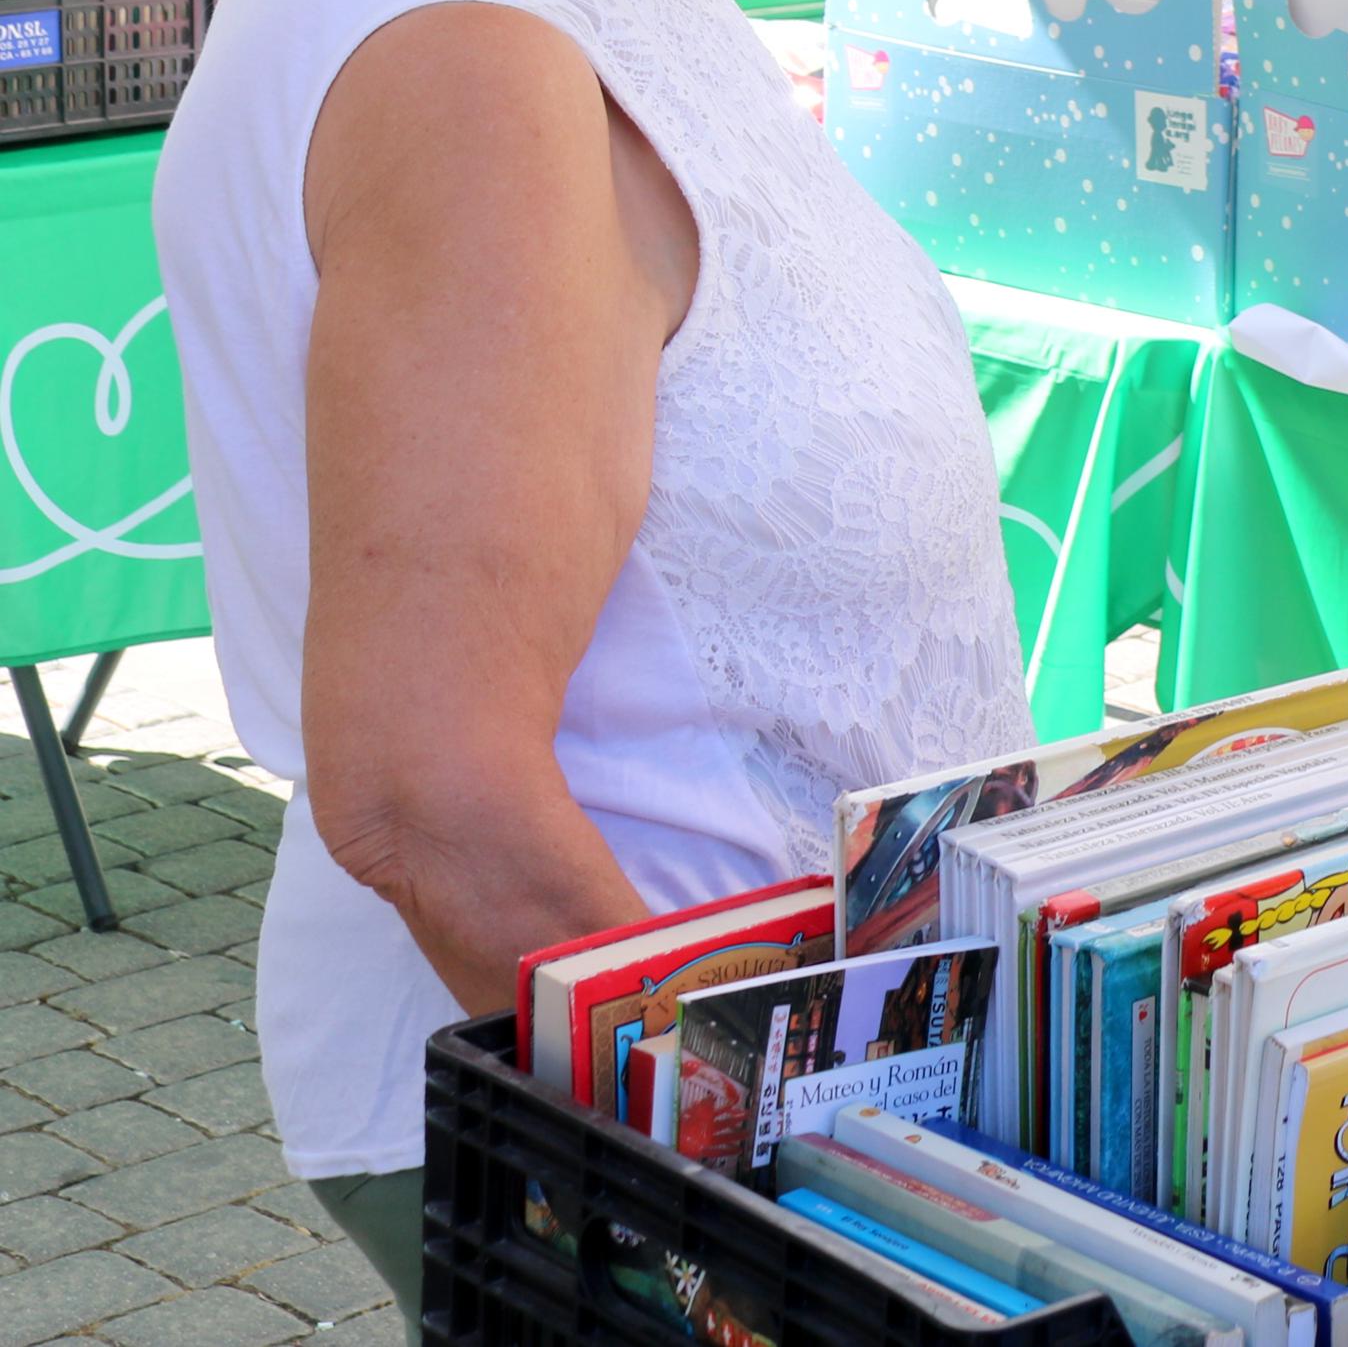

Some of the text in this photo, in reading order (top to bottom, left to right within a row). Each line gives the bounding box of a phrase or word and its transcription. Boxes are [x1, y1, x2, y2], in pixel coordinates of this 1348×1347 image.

[979, 802, 1062, 828] Naturaleza
[1000, 814, 1077, 841] Naturaleza
[1018, 824, 1097, 852] Naturaleza
[1142, 1037, 1153, 1068] TODA
[799, 1056, 960, 1111] Mateo y Román
[891, 1089, 931, 1108] caso
[932, 1076, 958, 1101] del
